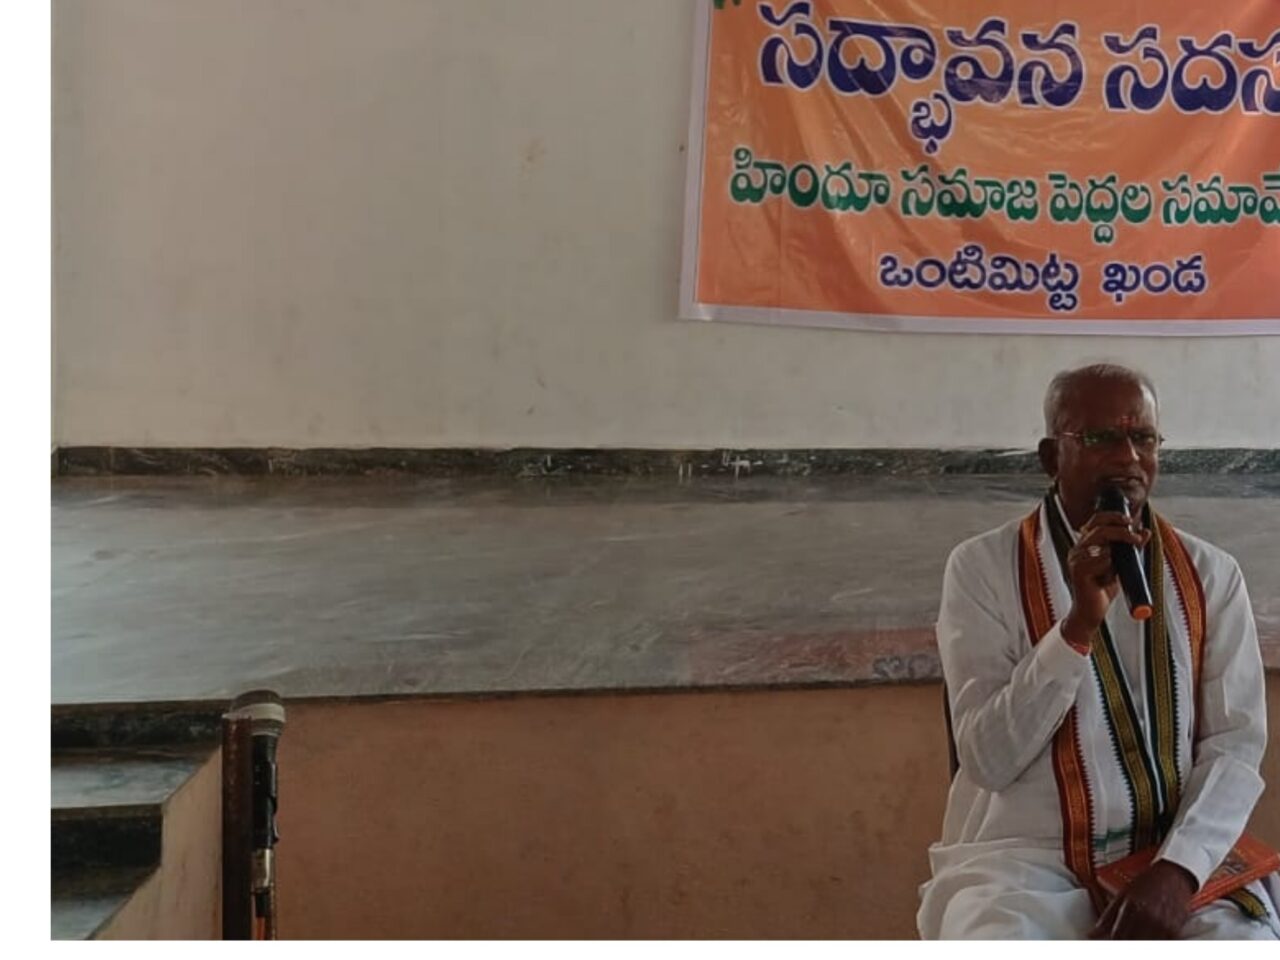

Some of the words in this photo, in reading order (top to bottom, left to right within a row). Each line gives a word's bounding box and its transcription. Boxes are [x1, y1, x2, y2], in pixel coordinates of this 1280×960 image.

[759, 2, 1084, 154] సద్భావన
[731, 148, 891, 213] హిందూ
[901, 164, 1040, 221] సమాజ
[1048, 173, 1151, 243] పెద్దల
[880, 245, 1080, 311] ఒంటిమిట్ట
[1102, 255, 1206, 302] ఖండ
